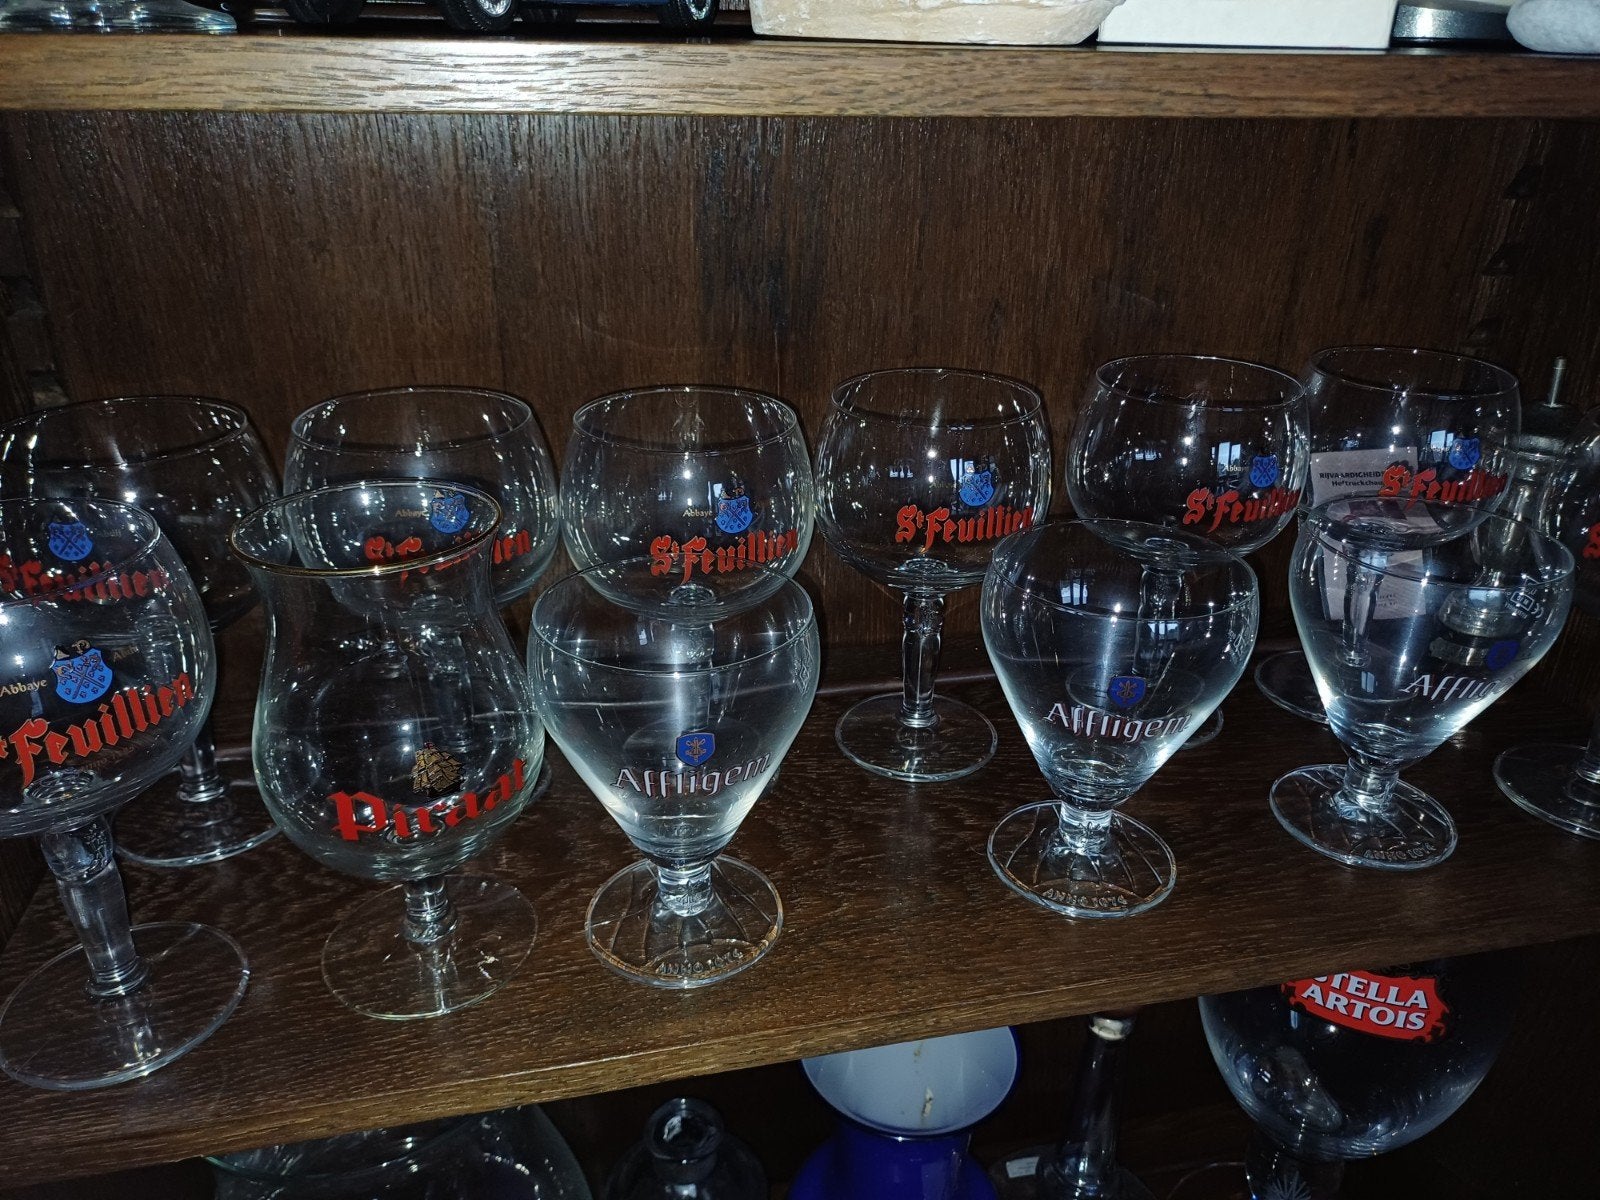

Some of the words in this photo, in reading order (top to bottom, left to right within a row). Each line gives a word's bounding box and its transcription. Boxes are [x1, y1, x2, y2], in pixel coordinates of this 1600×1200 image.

[1319, 471, 1384, 480] RIJVAARDIGHEID
[683, 508, 713, 518] Abbaye
[895, 504, 925, 544] St
[919, 504, 1034, 553] Feuillien
[650, 534, 680, 577] St
[681, 528, 799, 586] Feuillien
[0, 678, 47, 698] Abbaye
[9, 672, 194, 788] Feuillien
[1043, 702, 1192, 743] Affligem
[610, 753, 772, 798] Affligem
[326, 758, 527, 841] Piraat
[1300, 983, 1427, 1031] ARTOIS
[1313, 972, 1430, 1010] TELLA
